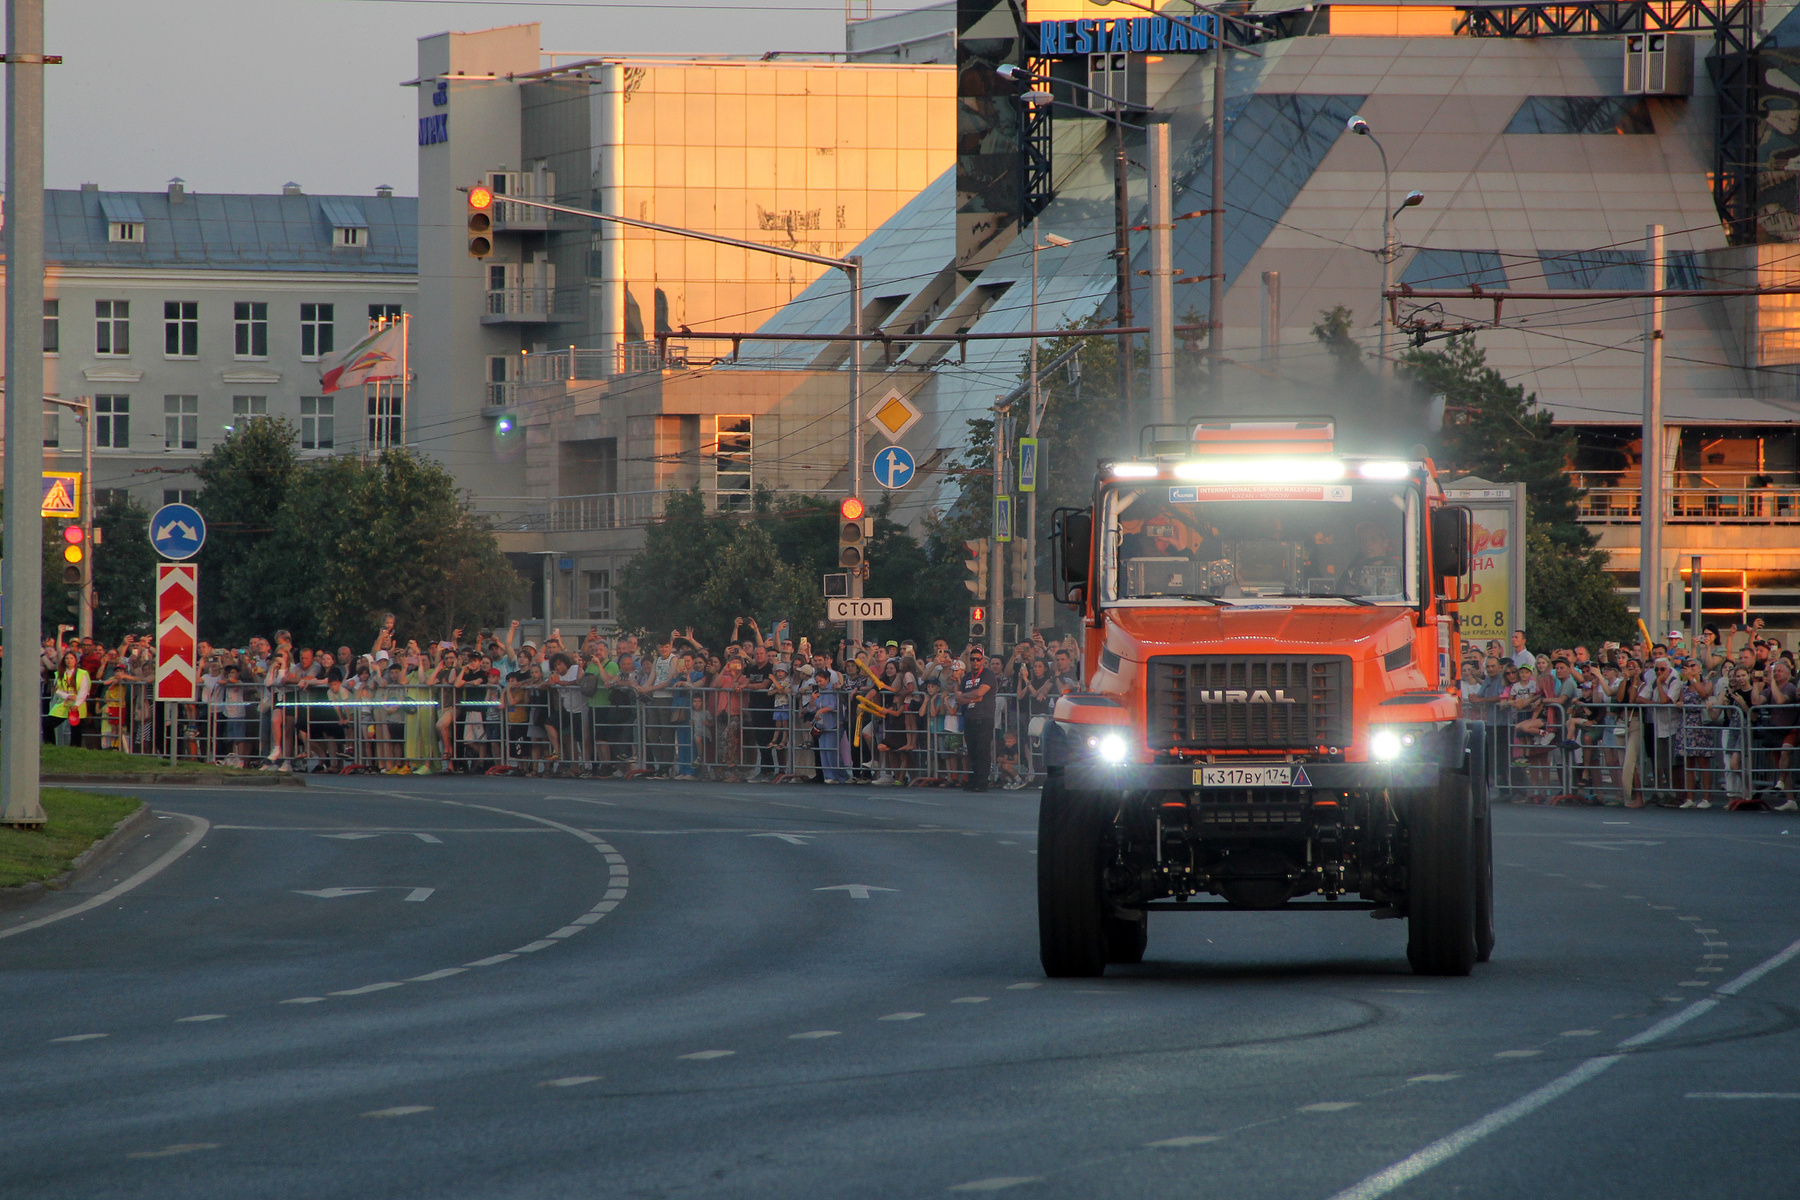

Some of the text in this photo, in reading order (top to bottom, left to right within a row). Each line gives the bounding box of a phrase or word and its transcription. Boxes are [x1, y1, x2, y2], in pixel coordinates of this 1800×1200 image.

[837, 602, 883, 616] СТОП
[1494, 610, 1504, 627] 8
[1200, 689, 1296, 704] URAL
[1265, 769, 1287, 780] 174
